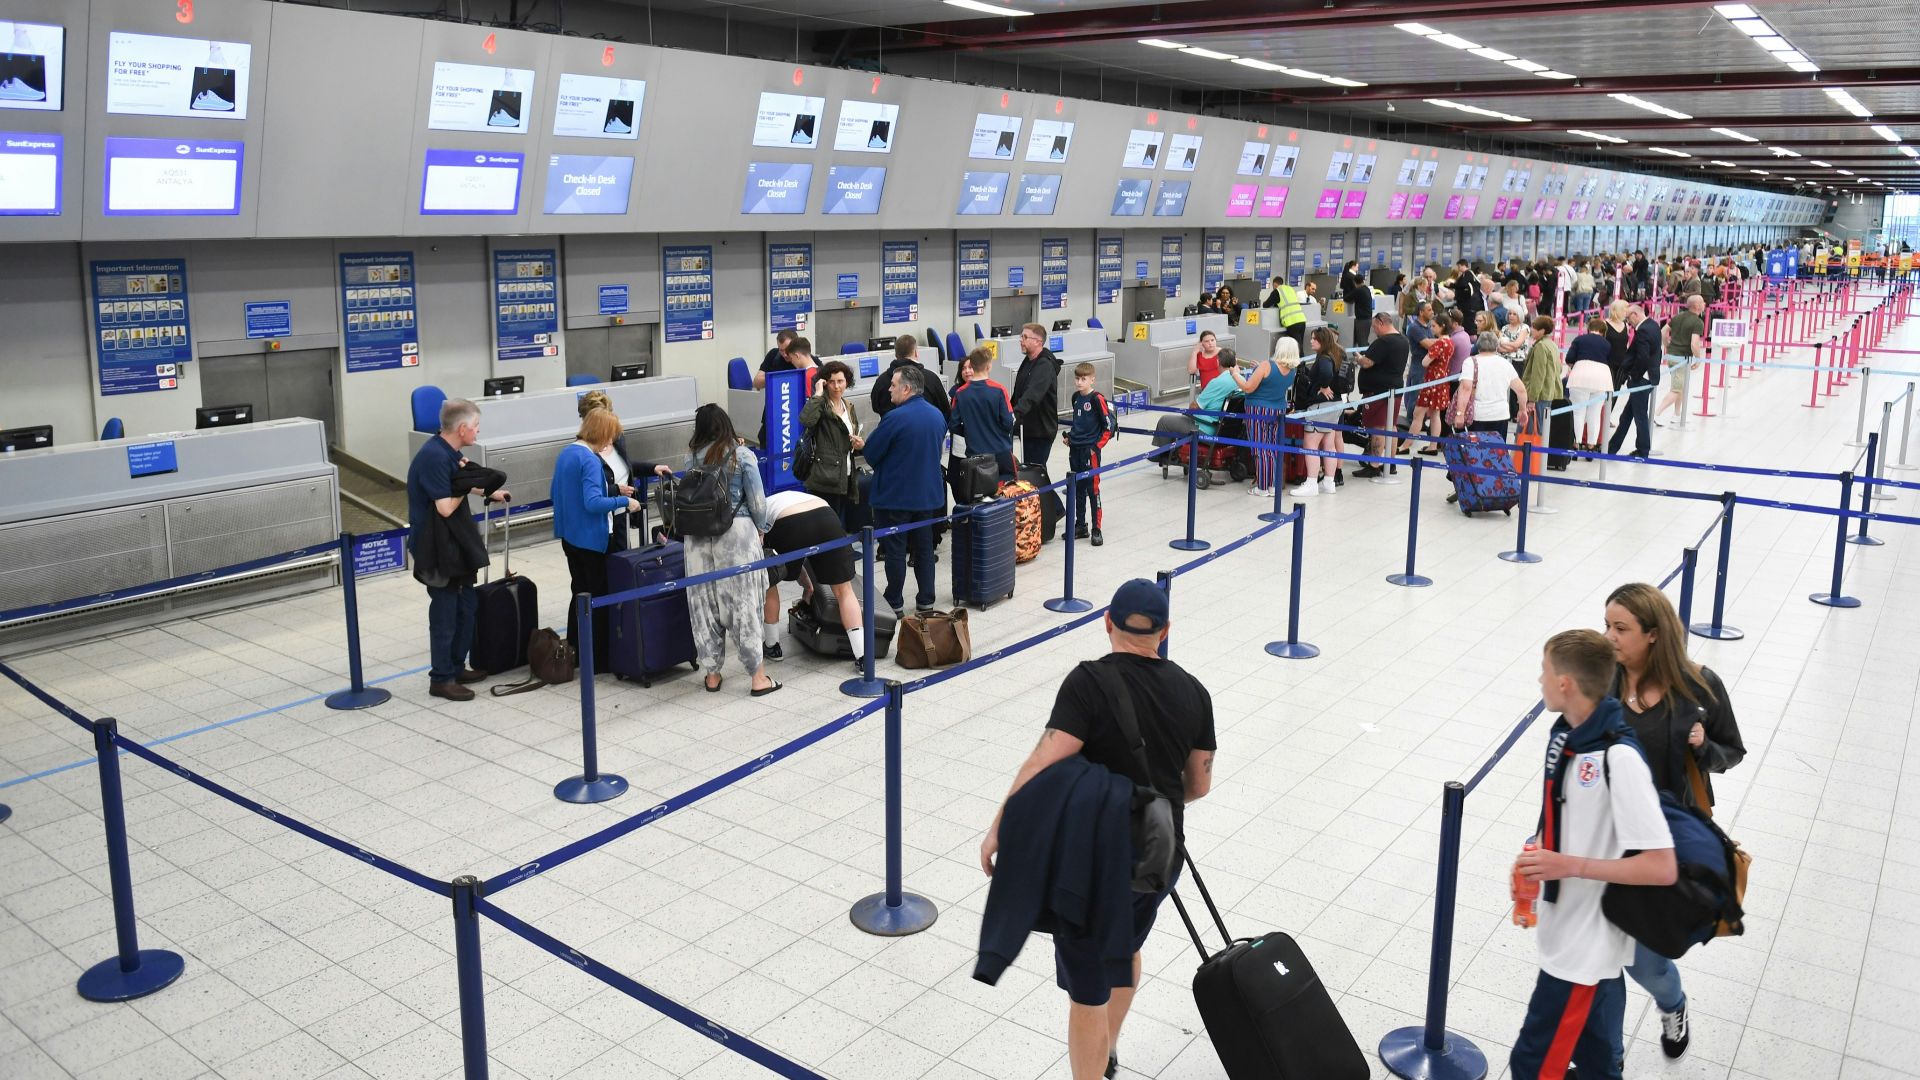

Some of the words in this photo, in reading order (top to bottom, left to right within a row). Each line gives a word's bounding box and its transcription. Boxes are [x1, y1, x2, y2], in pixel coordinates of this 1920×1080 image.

[176, 0, 194, 24] 3
[482, 31, 497, 55] 4
[601, 46, 616, 67] 5
[114, 60, 126, 68] FLY
[128, 61, 146, 69] YOUR
[148, 63, 182, 71] SHOPPING
[6, 139, 56, 149] SunExpress
[195, 146, 236, 154] SunExpress
[563, 174, 596, 184] Check-in
[597, 175, 616, 184] Desk
[758, 179, 783, 188] Check-in
[784, 180, 799, 188] Desk
[575, 186, 601, 197] Closed
[766, 190, 786, 198] Closed
[96, 265, 134, 273] Important
[136, 264, 179, 272] Information
[782, 382, 791, 453] RYANAIR
[362, 539, 389, 550] NOTICE
